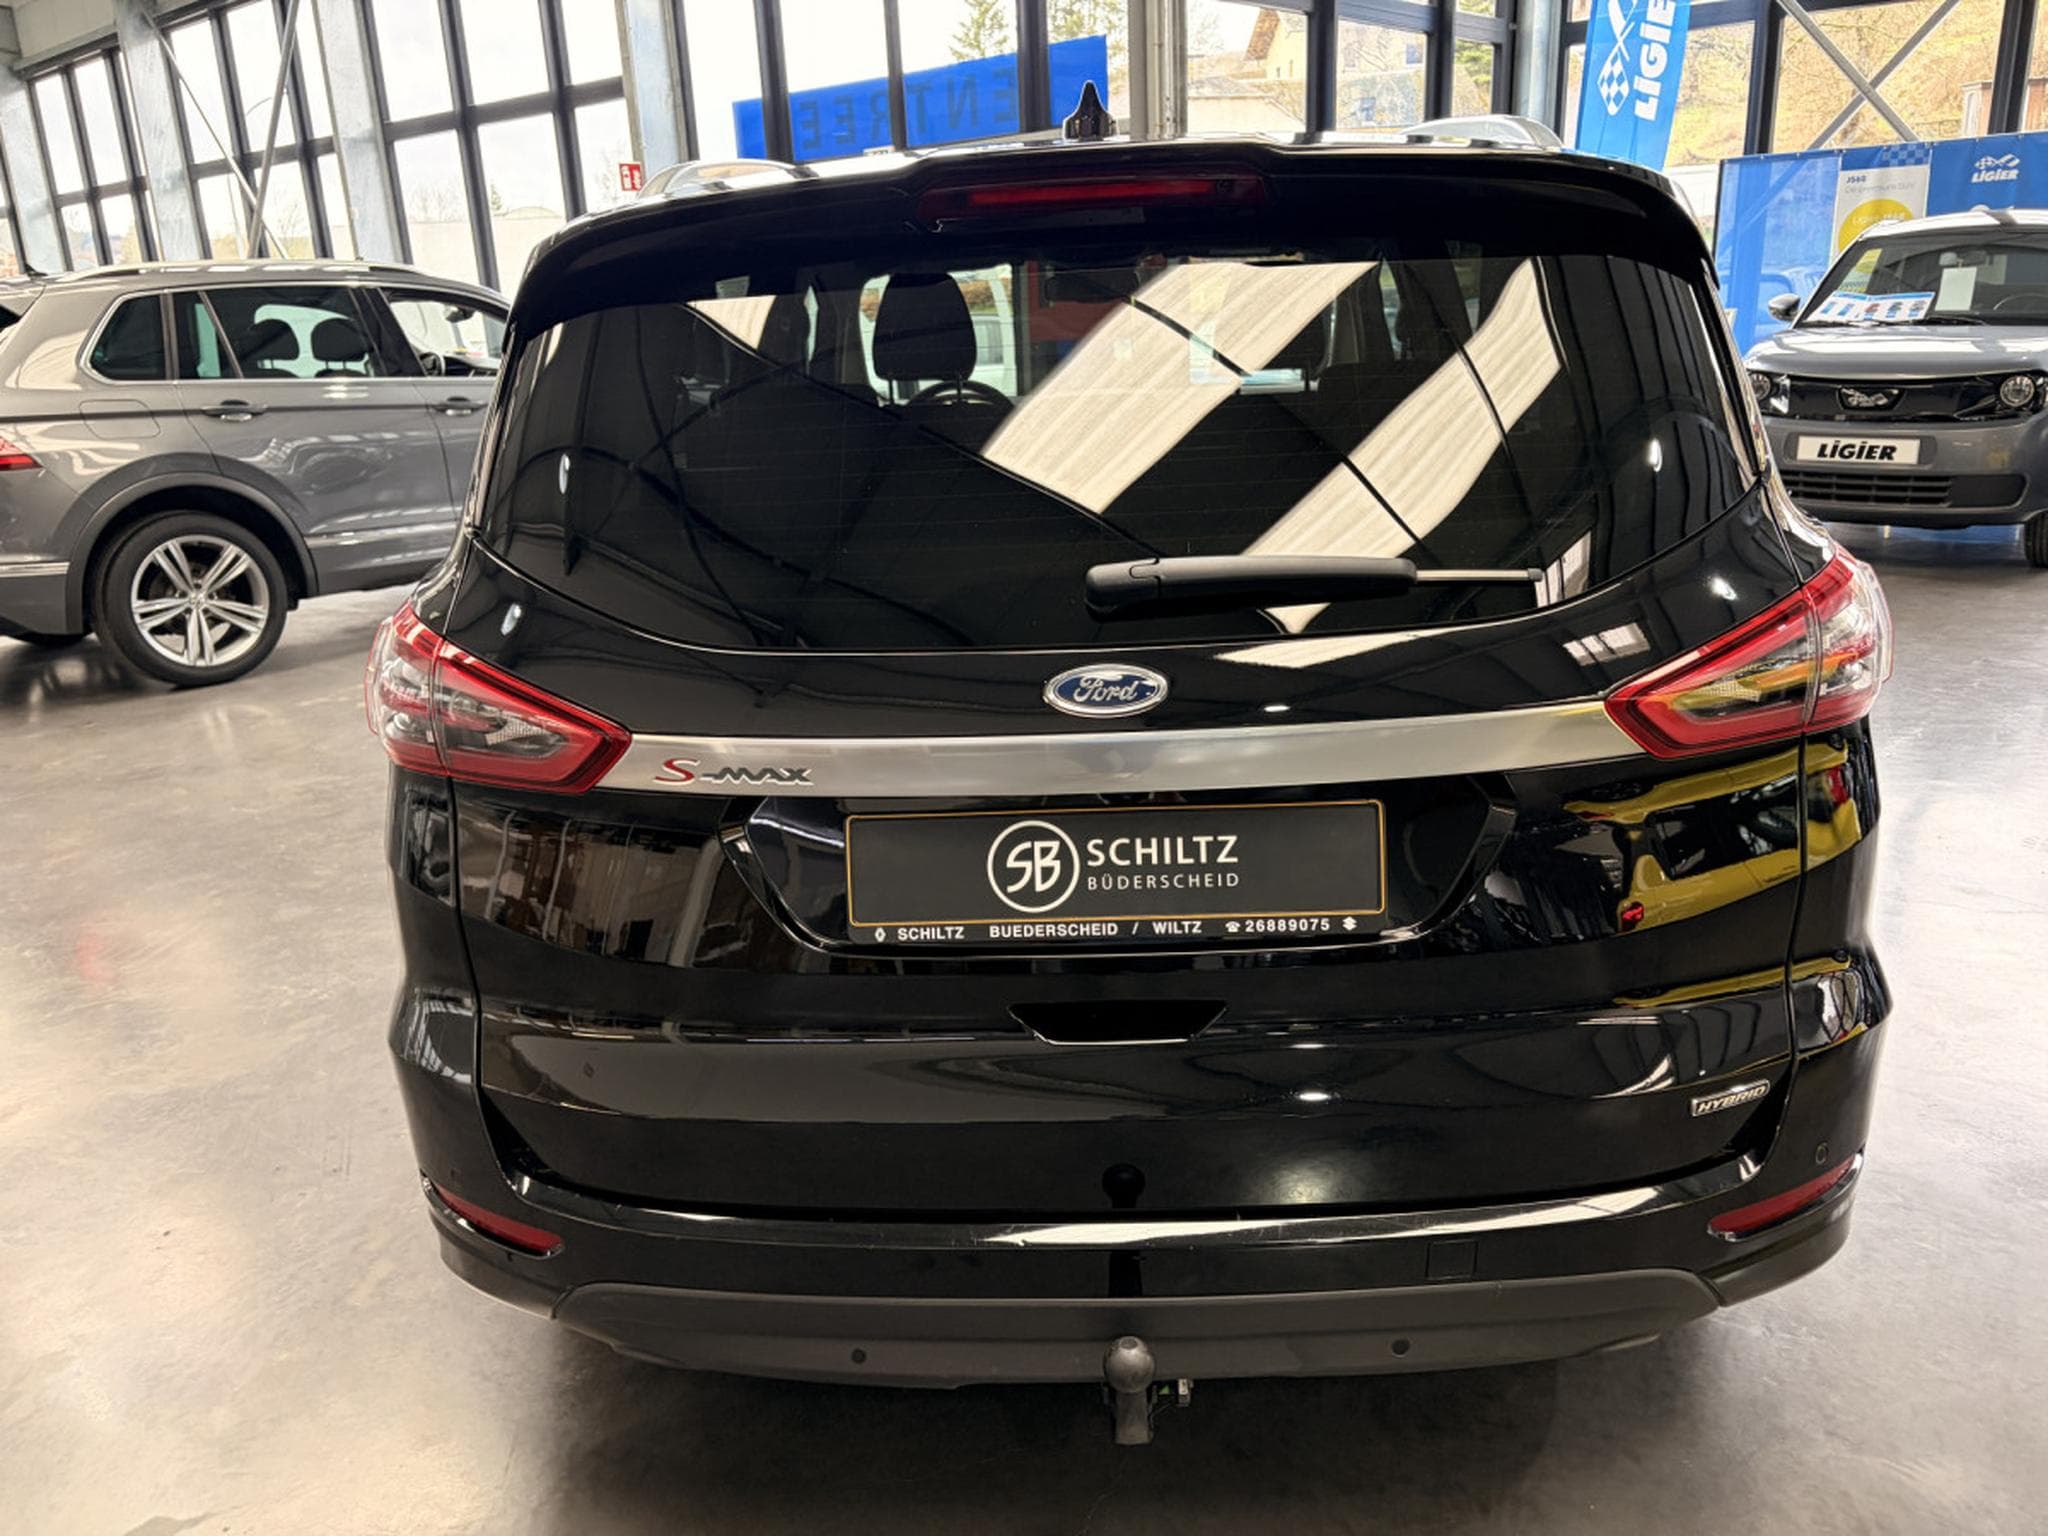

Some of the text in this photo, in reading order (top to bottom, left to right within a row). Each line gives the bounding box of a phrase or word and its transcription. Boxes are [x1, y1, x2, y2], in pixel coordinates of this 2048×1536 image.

[1073, 676, 1141, 702] Ford
[653, 758, 814, 786] S-MAX
[1087, 835, 1239, 867] SCHILTZ
[1006, 840, 1061, 893] SB
[1087, 873, 1240, 891] BÜDERSCHEID
[898, 926, 965, 941] SCHILTZ
[989, 923, 1119, 938] BUEDERSCHEID
[1152, 920, 1203, 934] WILTZ
[1245, 918, 1331, 933] 26889075
[1697, 1085, 1767, 1113] HYBRID
